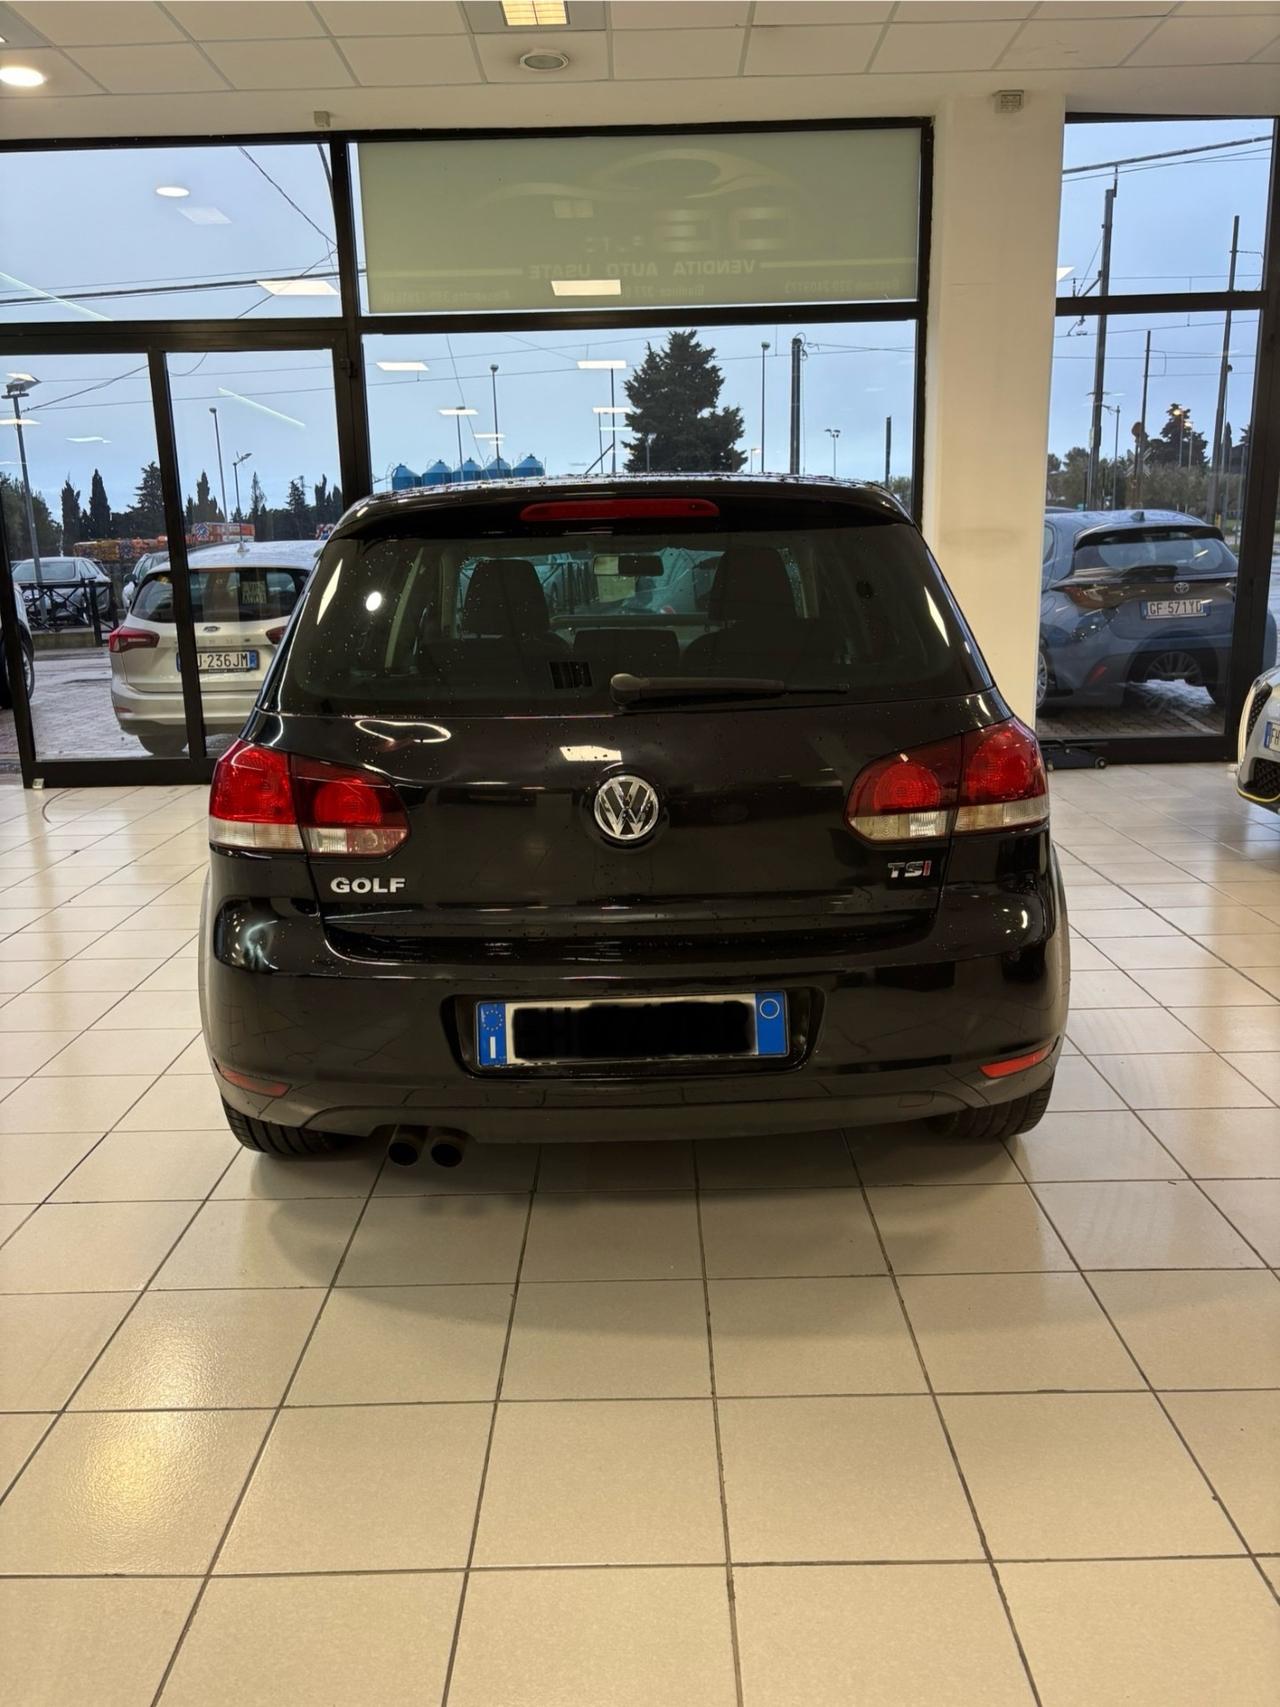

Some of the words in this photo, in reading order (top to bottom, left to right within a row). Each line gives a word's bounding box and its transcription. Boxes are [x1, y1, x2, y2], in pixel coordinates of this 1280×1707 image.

[1149, 602, 1163, 615] GF
[207, 653, 248, 668] 236JM
[330, 877, 406, 893] GOLF
